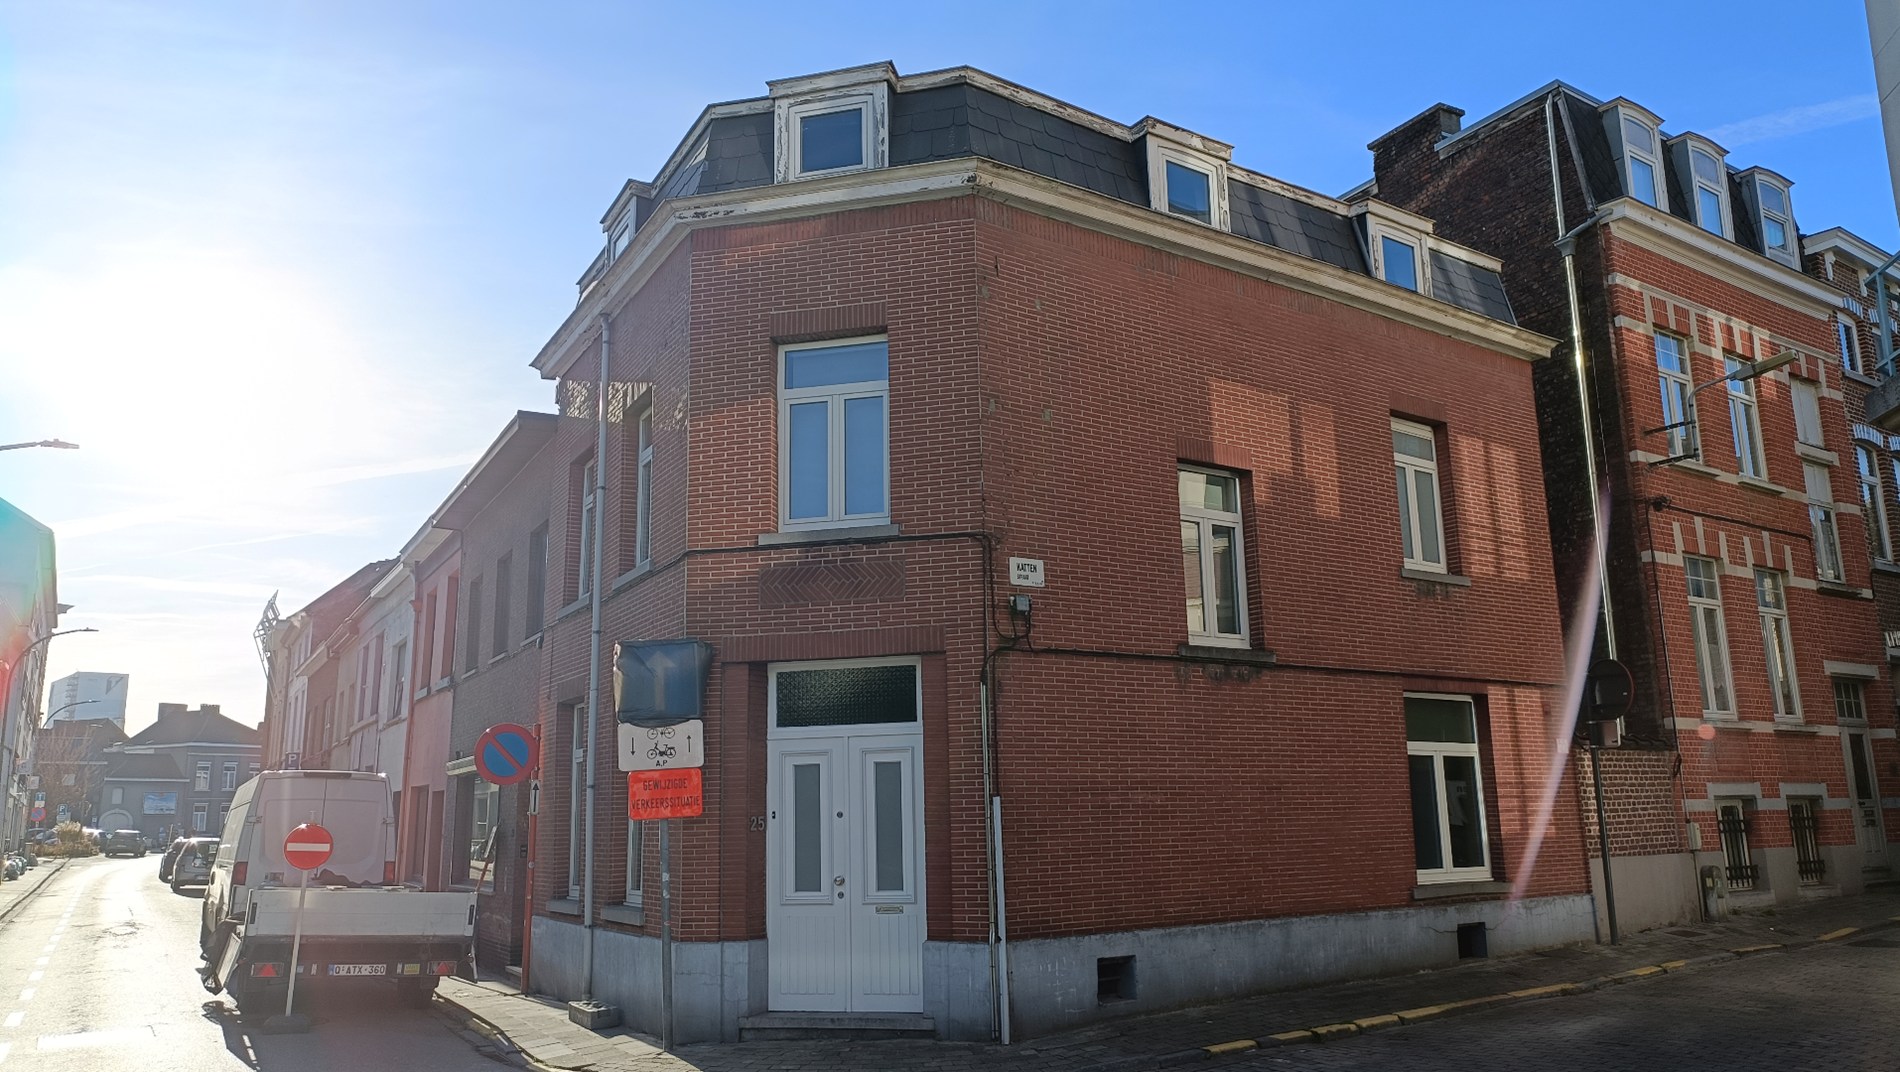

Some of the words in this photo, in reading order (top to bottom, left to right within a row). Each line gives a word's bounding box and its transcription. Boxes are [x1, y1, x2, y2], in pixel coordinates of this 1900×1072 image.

[1016, 563, 1037, 573] KATTEN
[289, 753, 296, 764] P
[642, 778, 688, 791] GEWIJZIGDE
[631, 796, 700, 810] VERKEERSSITUATIE
[750, 816, 765, 831] 25
